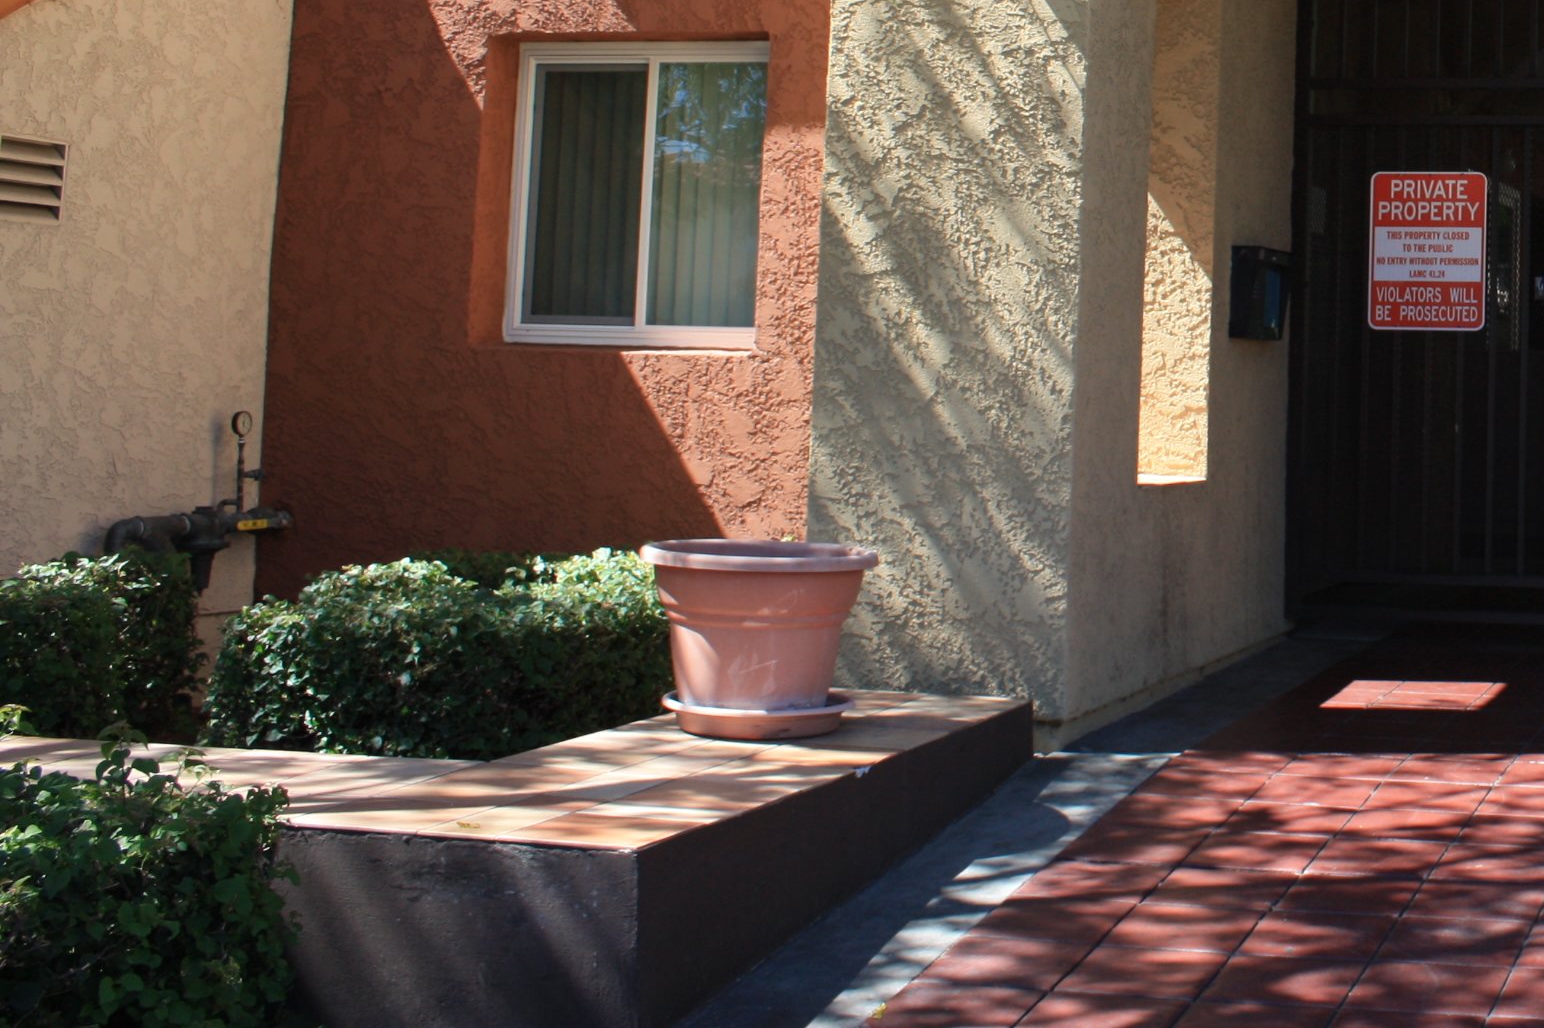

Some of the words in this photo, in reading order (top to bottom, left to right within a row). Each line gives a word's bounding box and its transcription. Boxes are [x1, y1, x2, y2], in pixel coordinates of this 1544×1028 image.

[1391, 180, 1468, 199] PRIVATE
[1378, 202, 1480, 221] PROPERTY
[1387, 231, 1402, 240] THIS
[1404, 231, 1441, 240] PROPERTY
[1443, 231, 1470, 240] CLOSED
[1403, 244, 1412, 252] TO
[1414, 244, 1427, 252] THE
[1428, 244, 1454, 253] PUBLIC
[1376, 257, 1386, 265] NO
[1387, 257, 1407, 265] ENTRY
[1409, 257, 1437, 265] WITHOUT
[1439, 257, 1479, 266] PERMISSION
[1409, 270, 1427, 278] LAMC
[1376, 287, 1442, 303] VIOLATORS
[1450, 288, 1478, 303] WILL
[1375, 305, 1392, 321] BE
[1400, 306, 1478, 322] PROSECUTED
